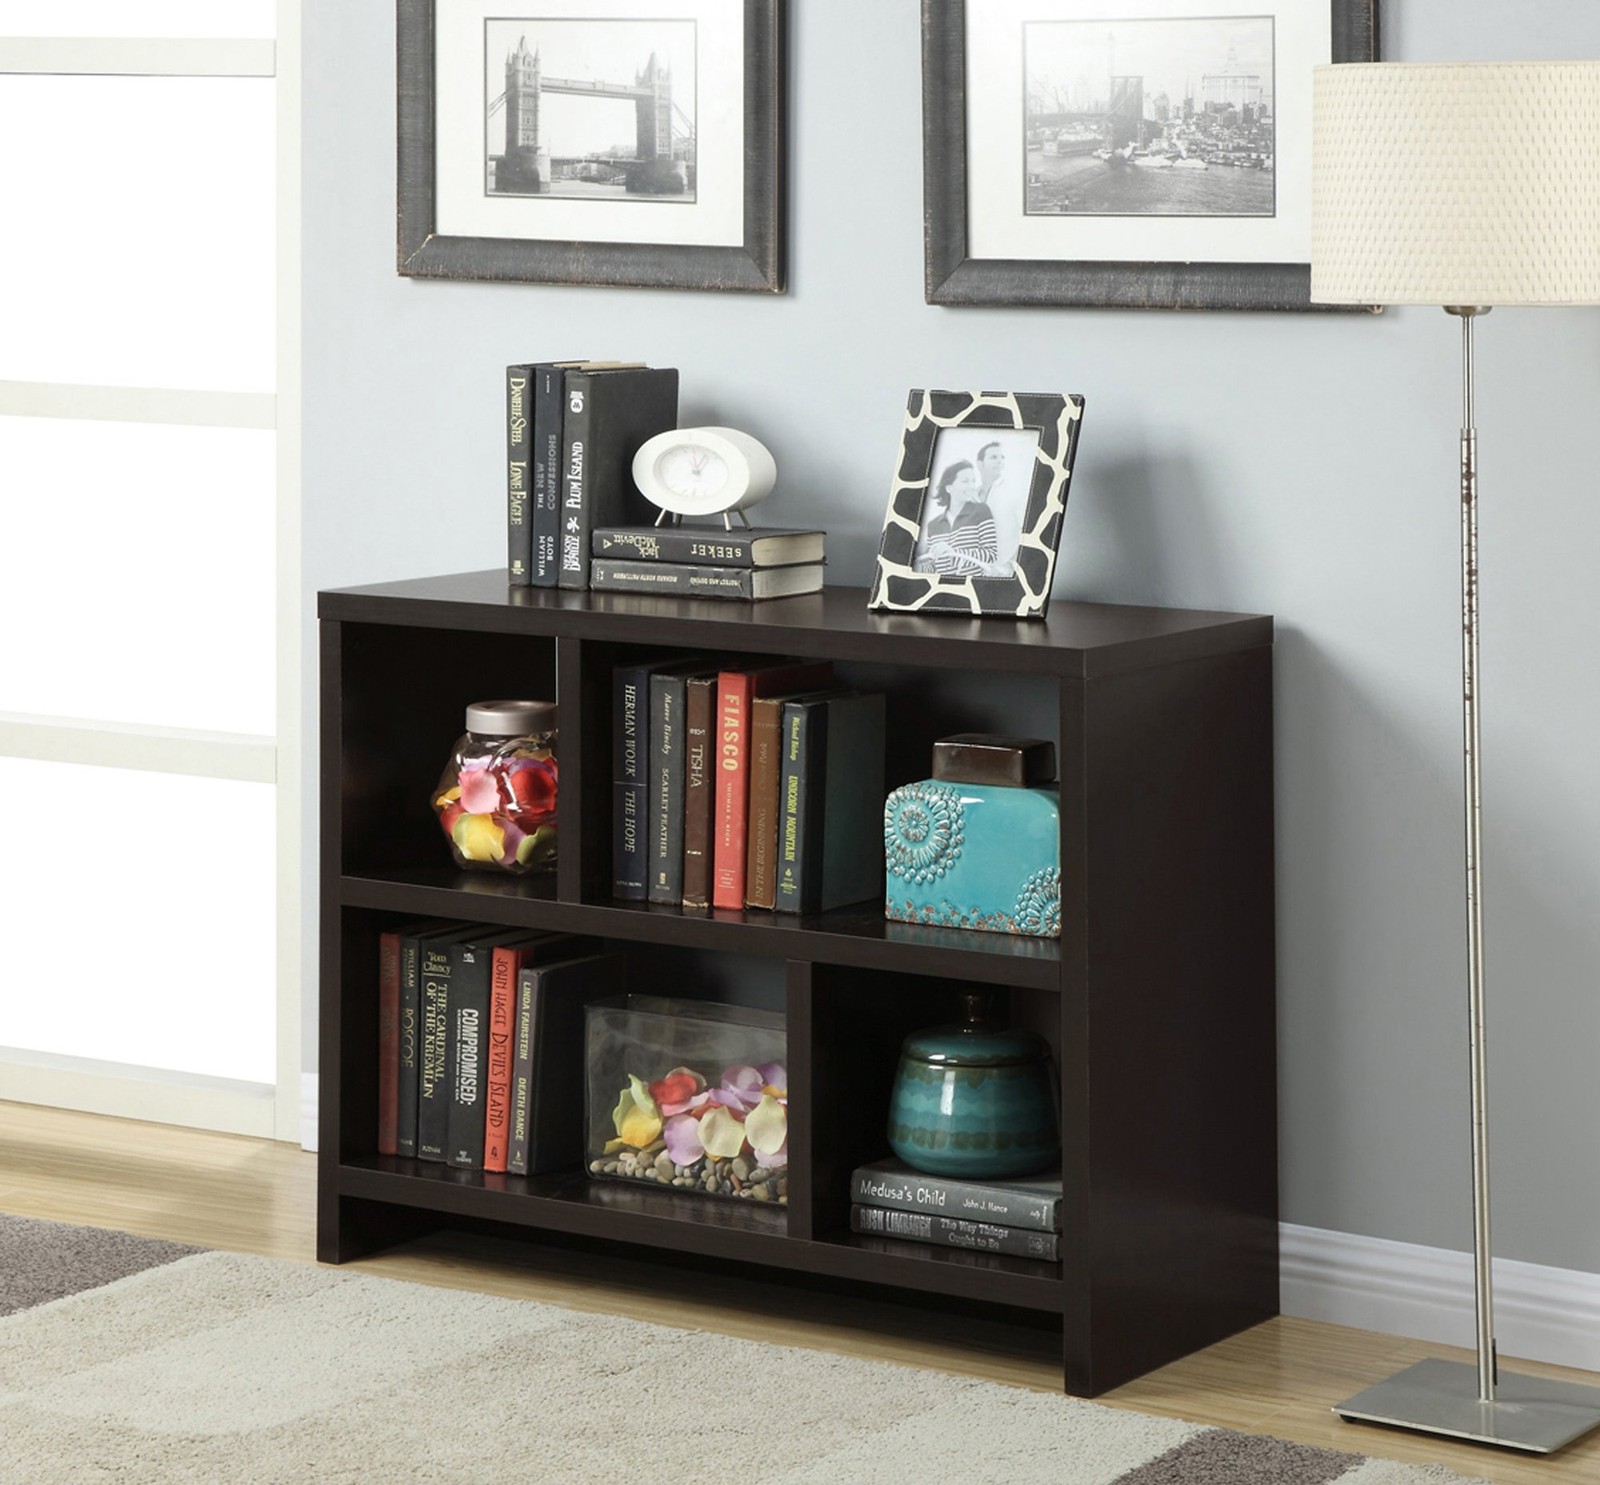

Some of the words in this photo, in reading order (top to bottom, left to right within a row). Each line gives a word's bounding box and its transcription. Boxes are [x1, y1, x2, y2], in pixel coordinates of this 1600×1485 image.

[510, 461, 526, 489] LONE
[535, 463, 545, 488] NEW
[547, 435, 557, 510] CONFESSIONS
[567, 442, 583, 480] ISLAND
[510, 491, 526, 525] EAGLE
[566, 481, 583, 509] PLUM
[538, 536, 546, 576] WILLIAM
[613, 534, 656, 547] McDevitt
[639, 545, 660, 558] Jack
[624, 684, 636, 736] HERMAN
[722, 694, 740, 771] FIASCO
[624, 740, 636, 777] WOUK
[690, 744, 703, 787] TISHA
[624, 791, 636, 816] THE
[661, 768, 670, 811] SCARLET
[787, 775, 798, 814] UNICORN
[624, 818, 636, 853] HOPE
[659, 814, 668, 858] FEATHER
[756, 808, 767, 865] BEGINNING
[785, 816, 797, 861] MOUNTAIN
[427, 951, 447, 962] Tom
[495, 958, 509, 990] JOHN
[426, 982, 438, 1002] OF
[437, 983, 448, 1013] THE
[494, 992, 507, 1026] HAGEE
[522, 981, 532, 1010] LINDA
[425, 1003, 437, 1033] THE
[403, 1008, 414, 1068] ROSCOE
[435, 1014, 447, 1082] CARDINAL
[519, 1011, 530, 1060] FAIRSTEIN
[423, 1034, 435, 1099] KREMLIN
[460, 1008, 479, 1105] COMPROMISED:
[489, 1081, 507, 1128] ISLAND
[517, 1077, 527, 1108] DEATH
[515, 1109, 525, 1142] DANCE
[860, 1180, 913, 1201] Medusa's
[916, 1187, 946, 1206] Child
[962, 1198, 979, 1208] John
[941, 1217, 957, 1231] The
[959, 1220, 977, 1235] Way
[979, 1223, 1009, 1239] Things
[977, 1237, 987, 1247] to
[988, 1238, 1000, 1250] Be
